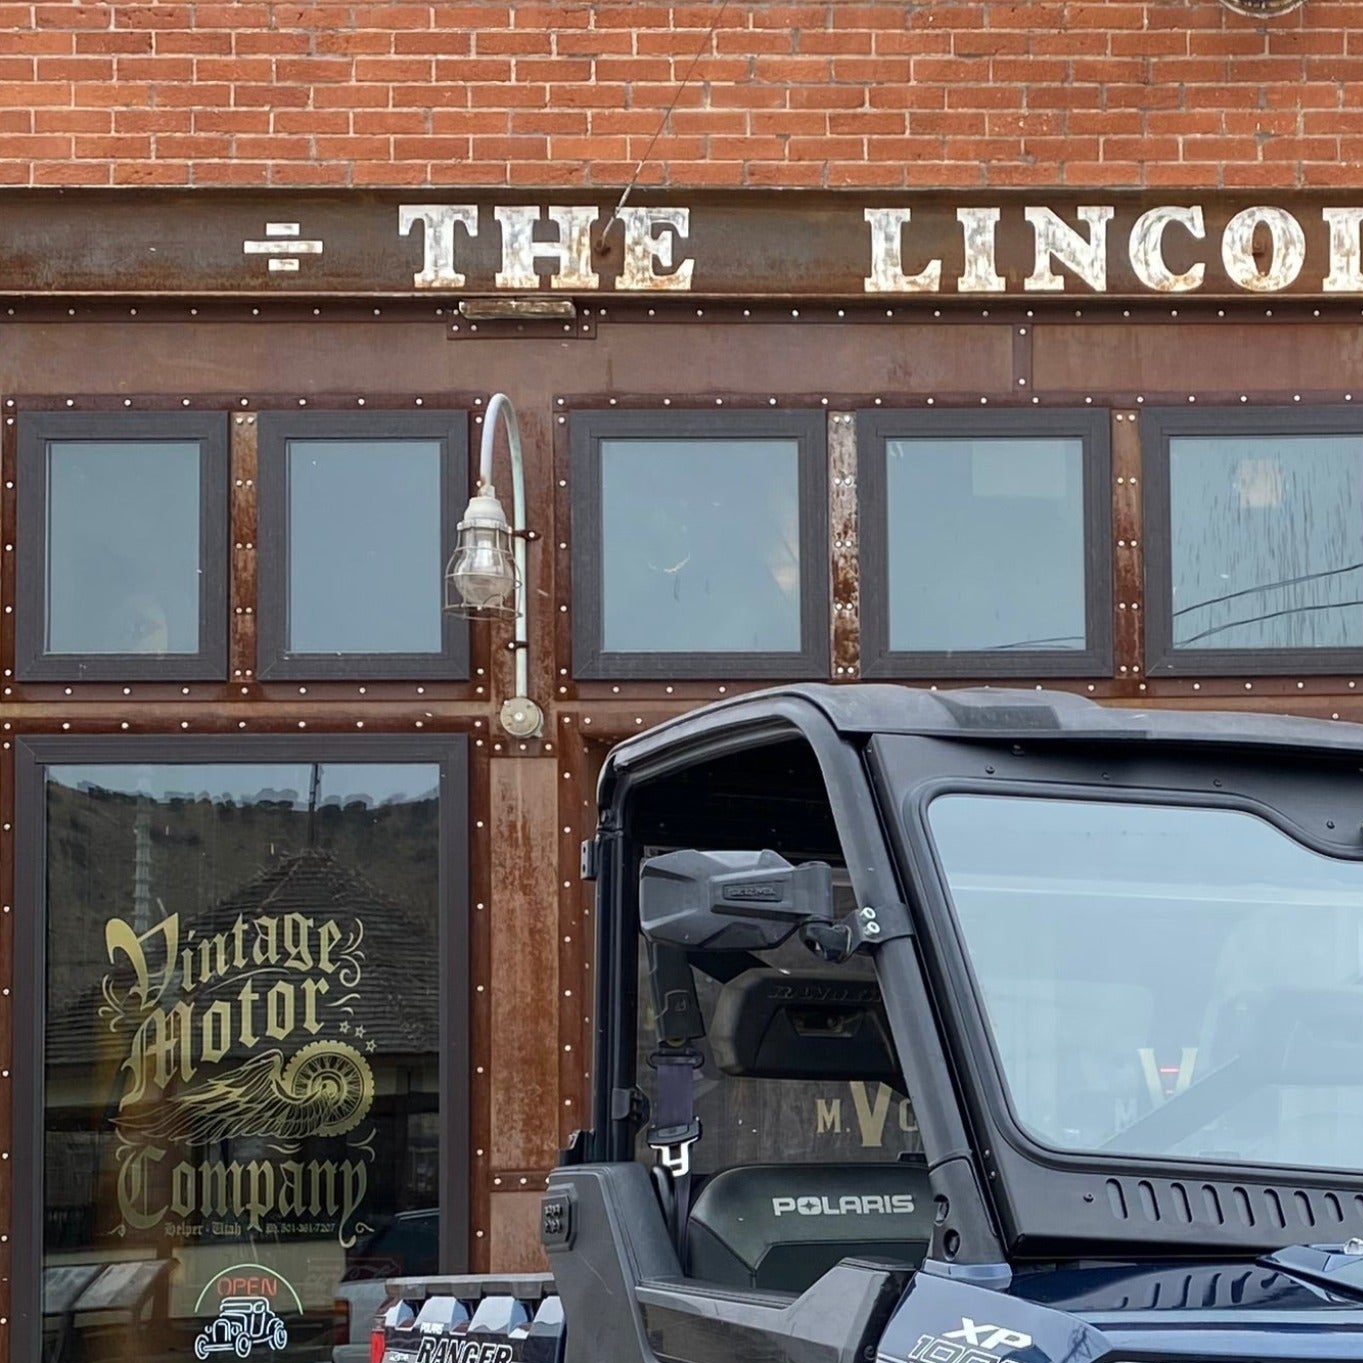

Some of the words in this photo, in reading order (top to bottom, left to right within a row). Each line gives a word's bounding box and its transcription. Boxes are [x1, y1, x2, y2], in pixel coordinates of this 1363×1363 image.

[398, 204, 696, 291] THE
[105, 911, 342, 1011] Vintage
[119, 976, 331, 1112] Motor
[117, 1144, 368, 1248] Company
[772, 1194, 915, 1216] POLARIS
[216, 1276, 278, 1297] OPEN
[942, 1316, 1032, 1350] XP
